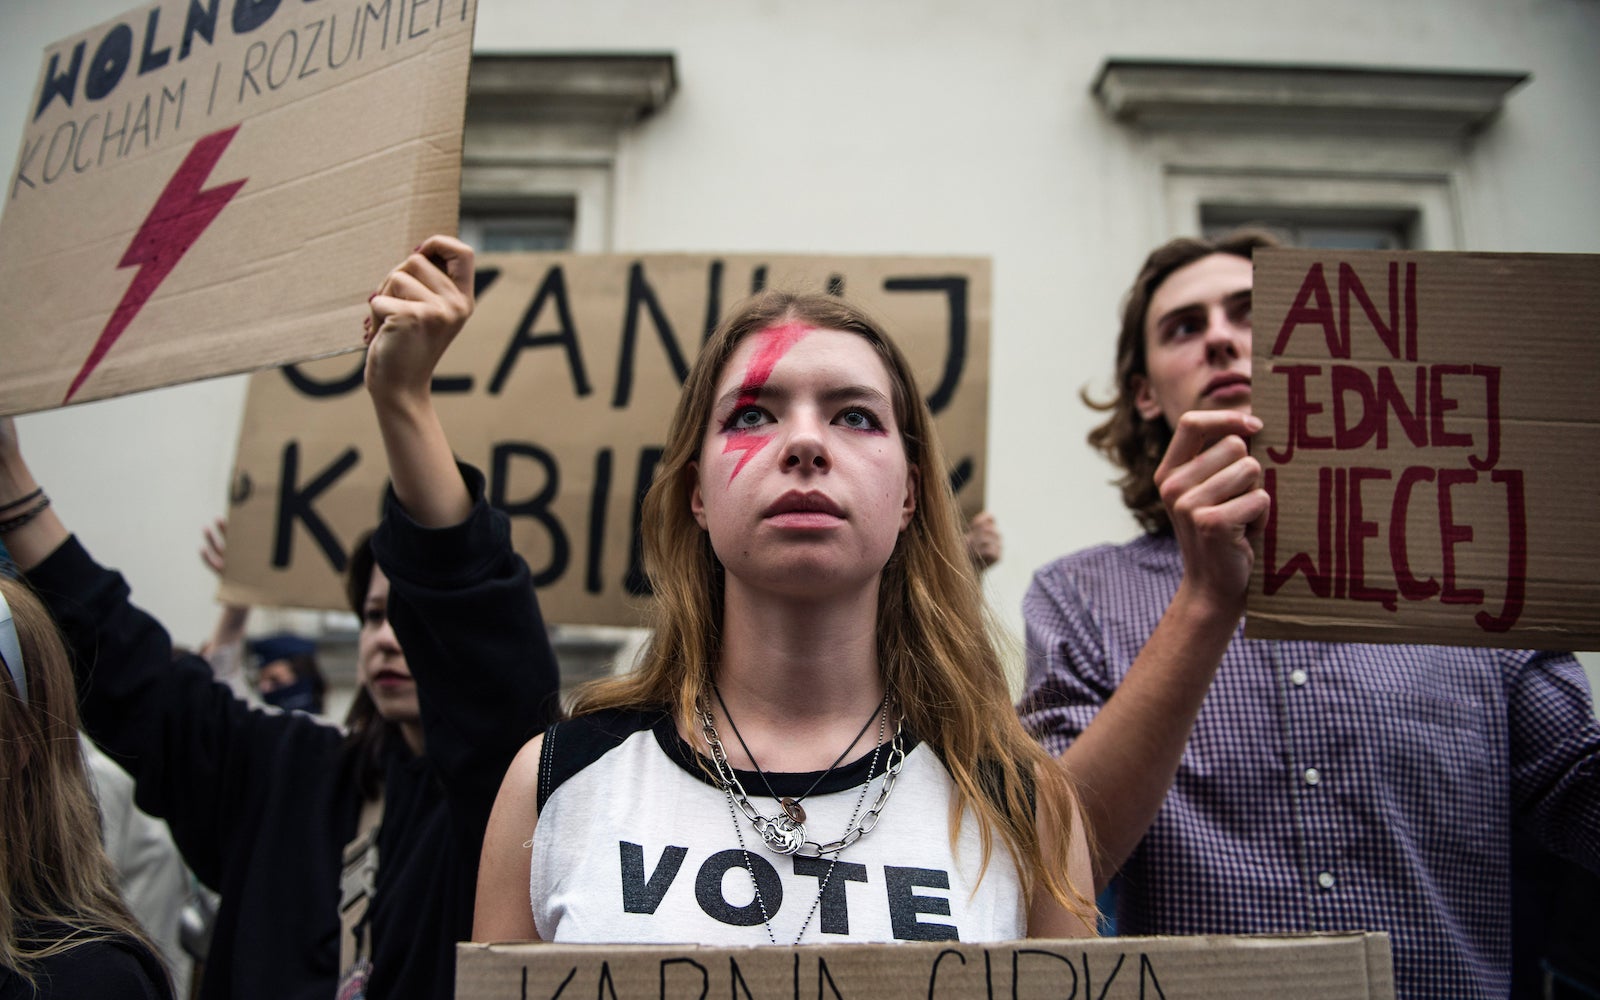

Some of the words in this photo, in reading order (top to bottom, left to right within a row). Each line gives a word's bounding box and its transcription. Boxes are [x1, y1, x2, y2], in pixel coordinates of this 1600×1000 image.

[12, 78, 186, 199] KOCHAM
[207, 62, 221, 116] I
[1272, 261, 1418, 361] ANI
[1266, 364, 1501, 471] JEDNEJ
[1263, 465, 1527, 632] WIĘCEJ
[619, 840, 960, 942] VOTE
